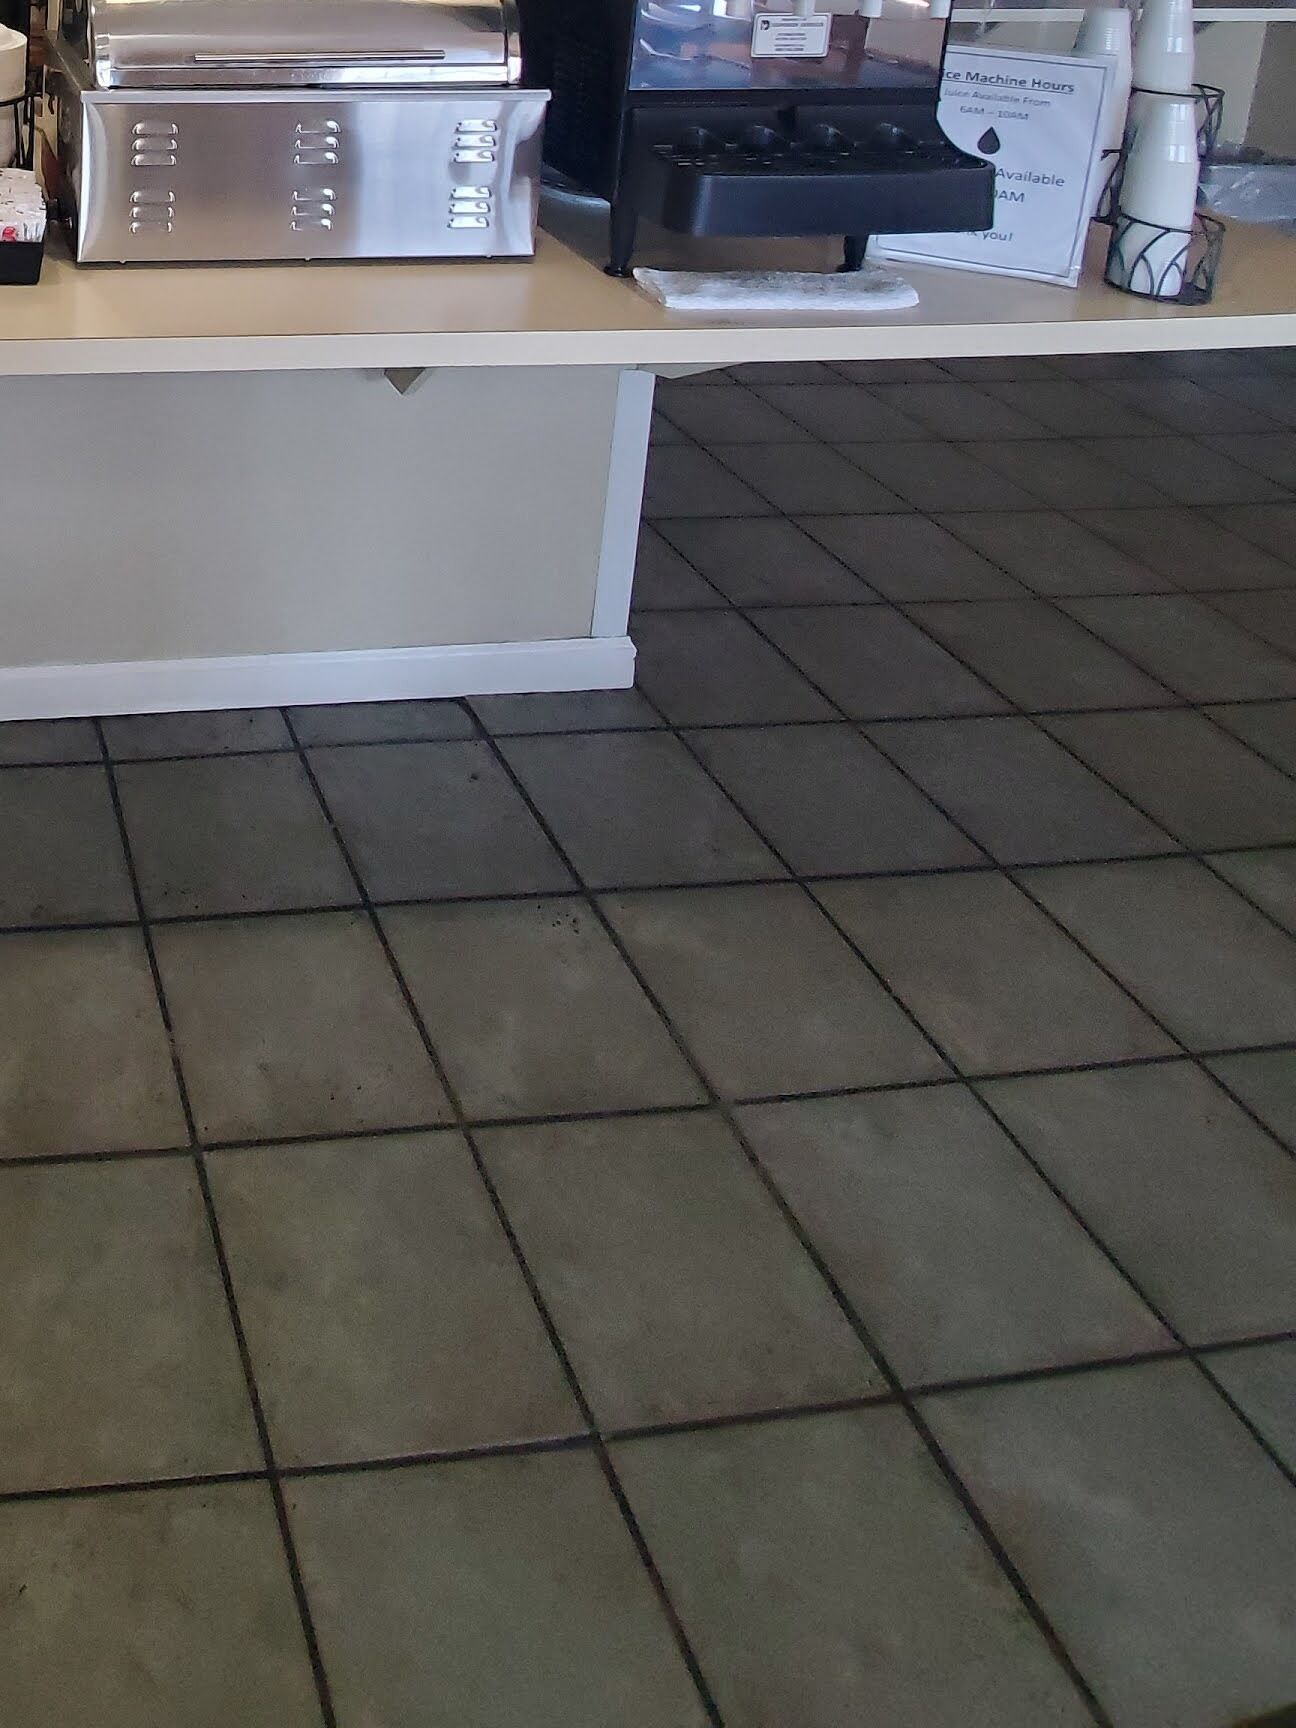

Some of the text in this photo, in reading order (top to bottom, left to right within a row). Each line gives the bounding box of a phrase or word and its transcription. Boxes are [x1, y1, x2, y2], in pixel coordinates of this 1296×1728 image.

[965, 71, 1027, 88] Machine
[1031, 78, 1075, 93] Hours
[1022, 96, 1051, 108] From
[995, 168, 1065, 187] Available
